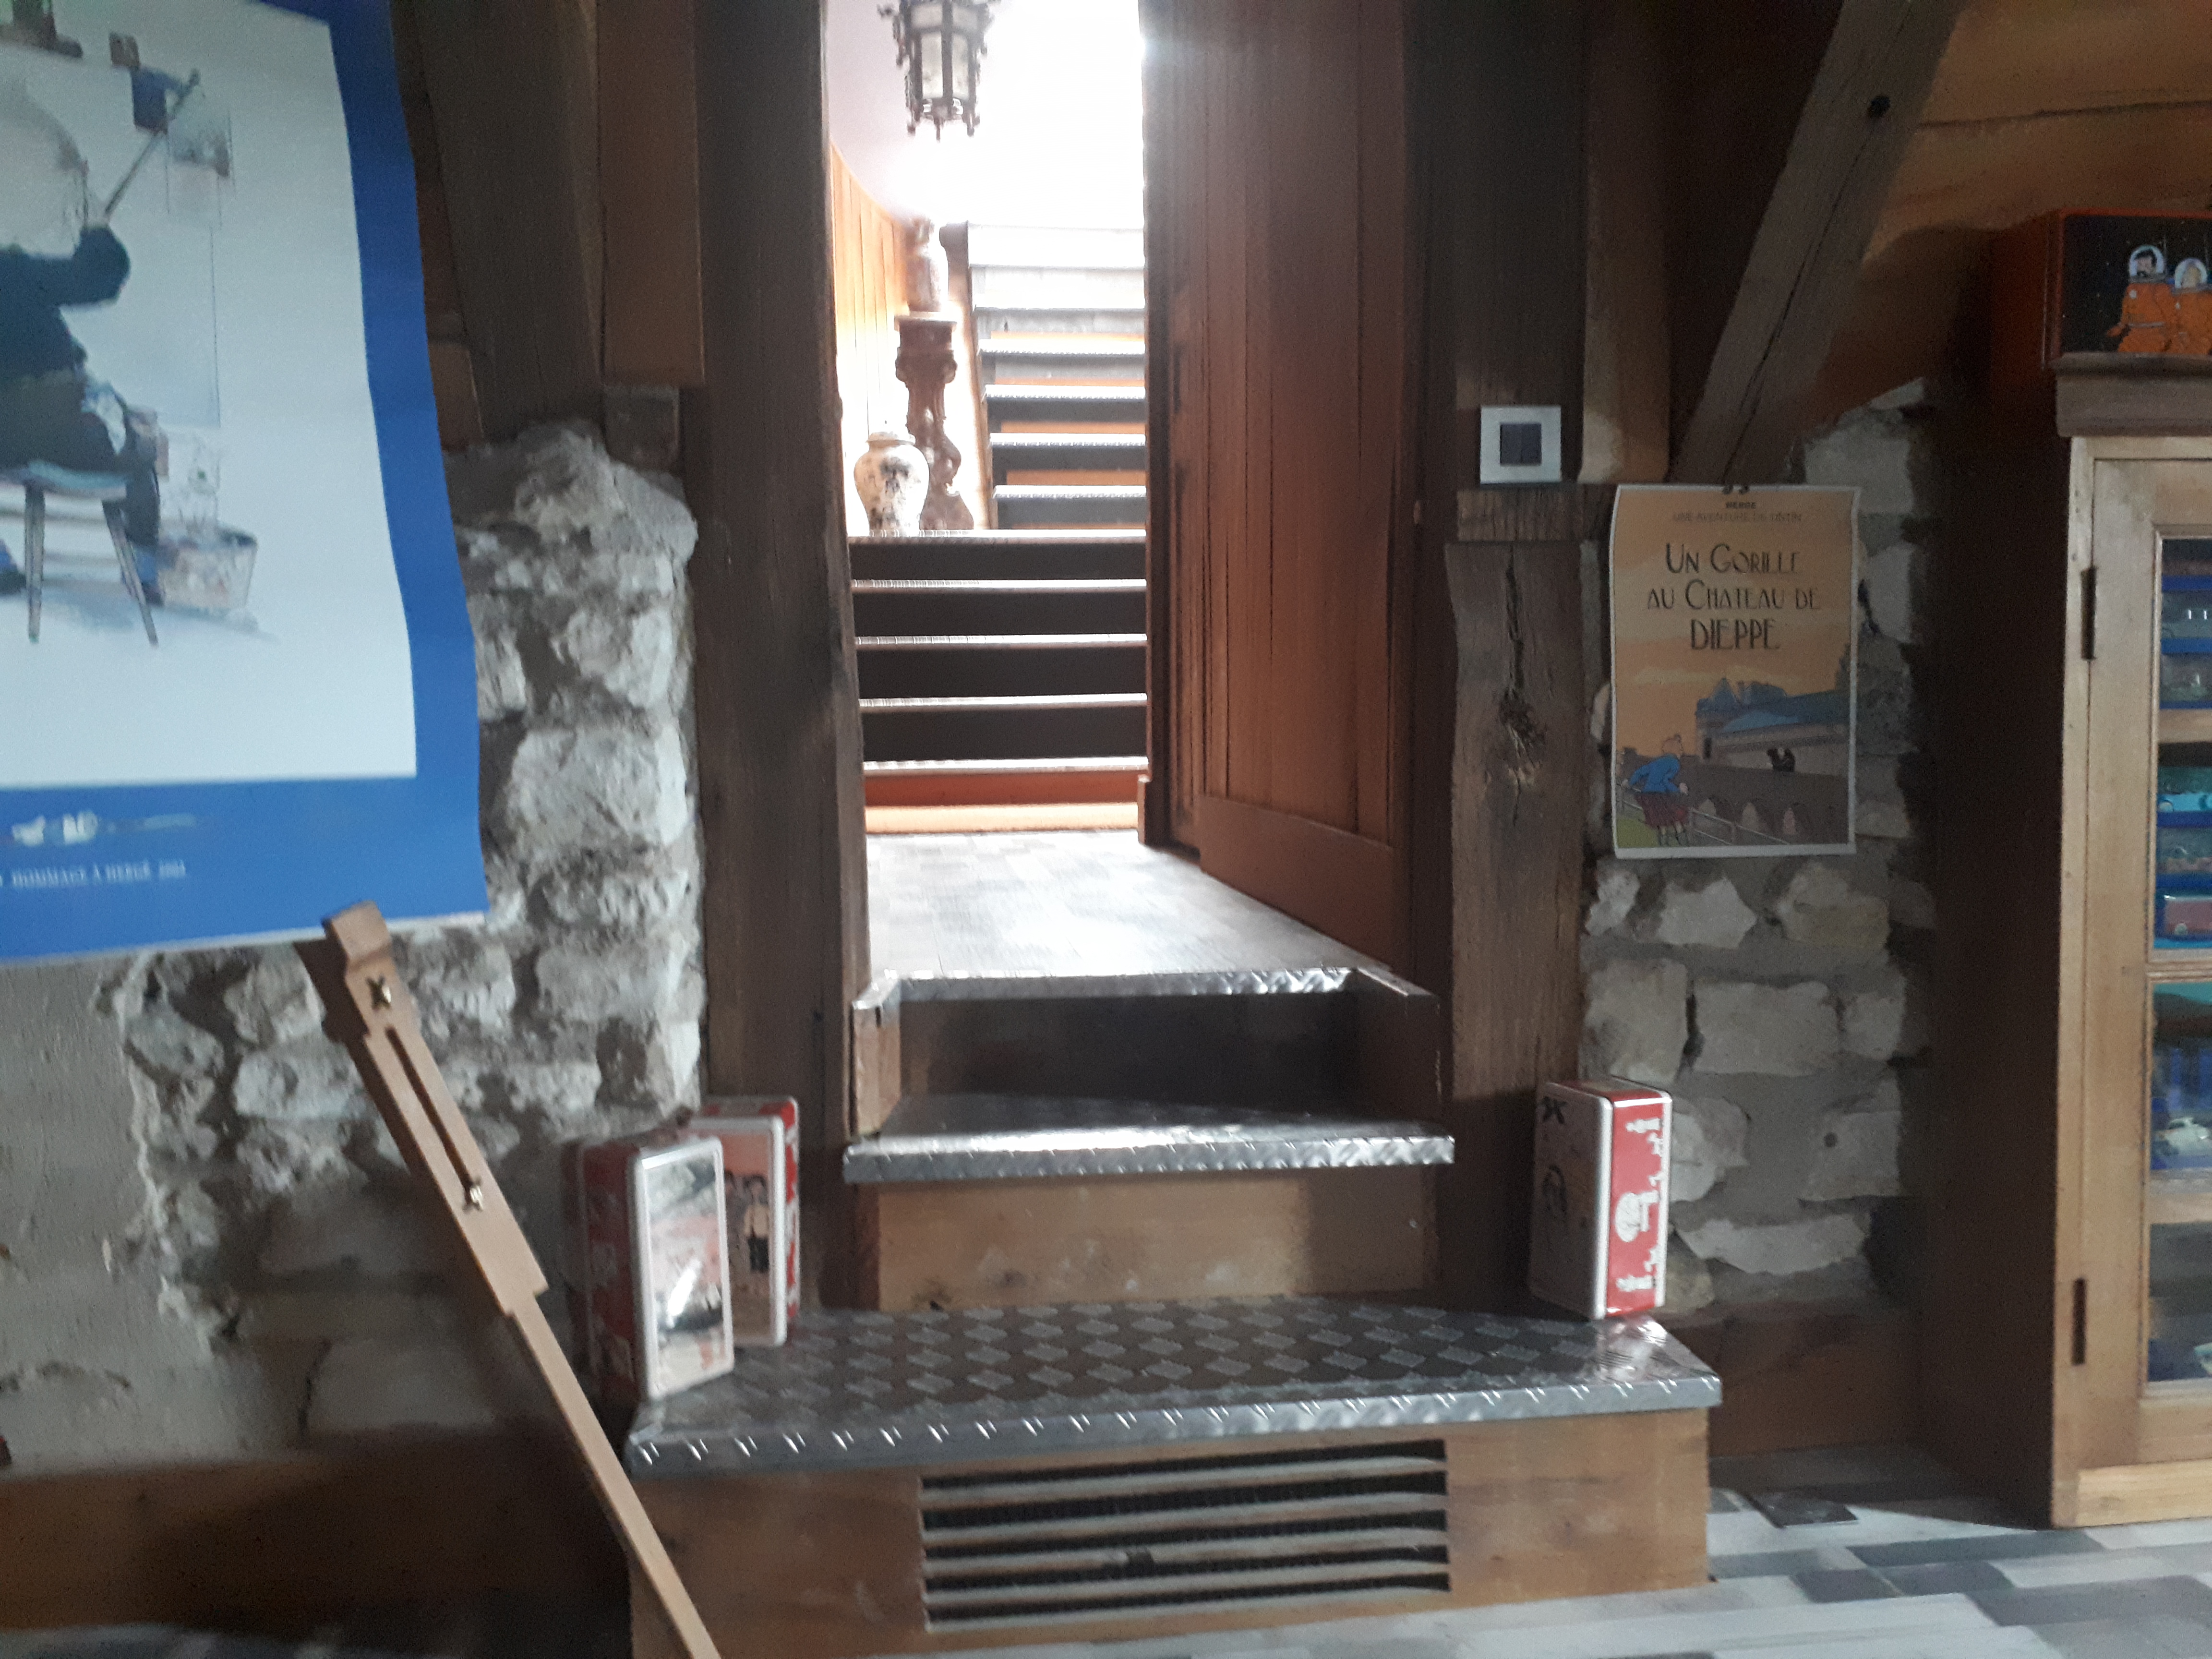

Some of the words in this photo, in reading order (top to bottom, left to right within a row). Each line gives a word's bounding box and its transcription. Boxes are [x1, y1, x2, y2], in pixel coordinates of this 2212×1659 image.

[1665, 543, 1700, 574] UN
[1710, 543, 1803, 575] GORILLE
[1647, 587, 1674, 610] AU
[1684, 579, 1785, 610] CHATEAU
[1795, 587, 1821, 610] DE
[1690, 618, 1781, 650] DIEPPE
